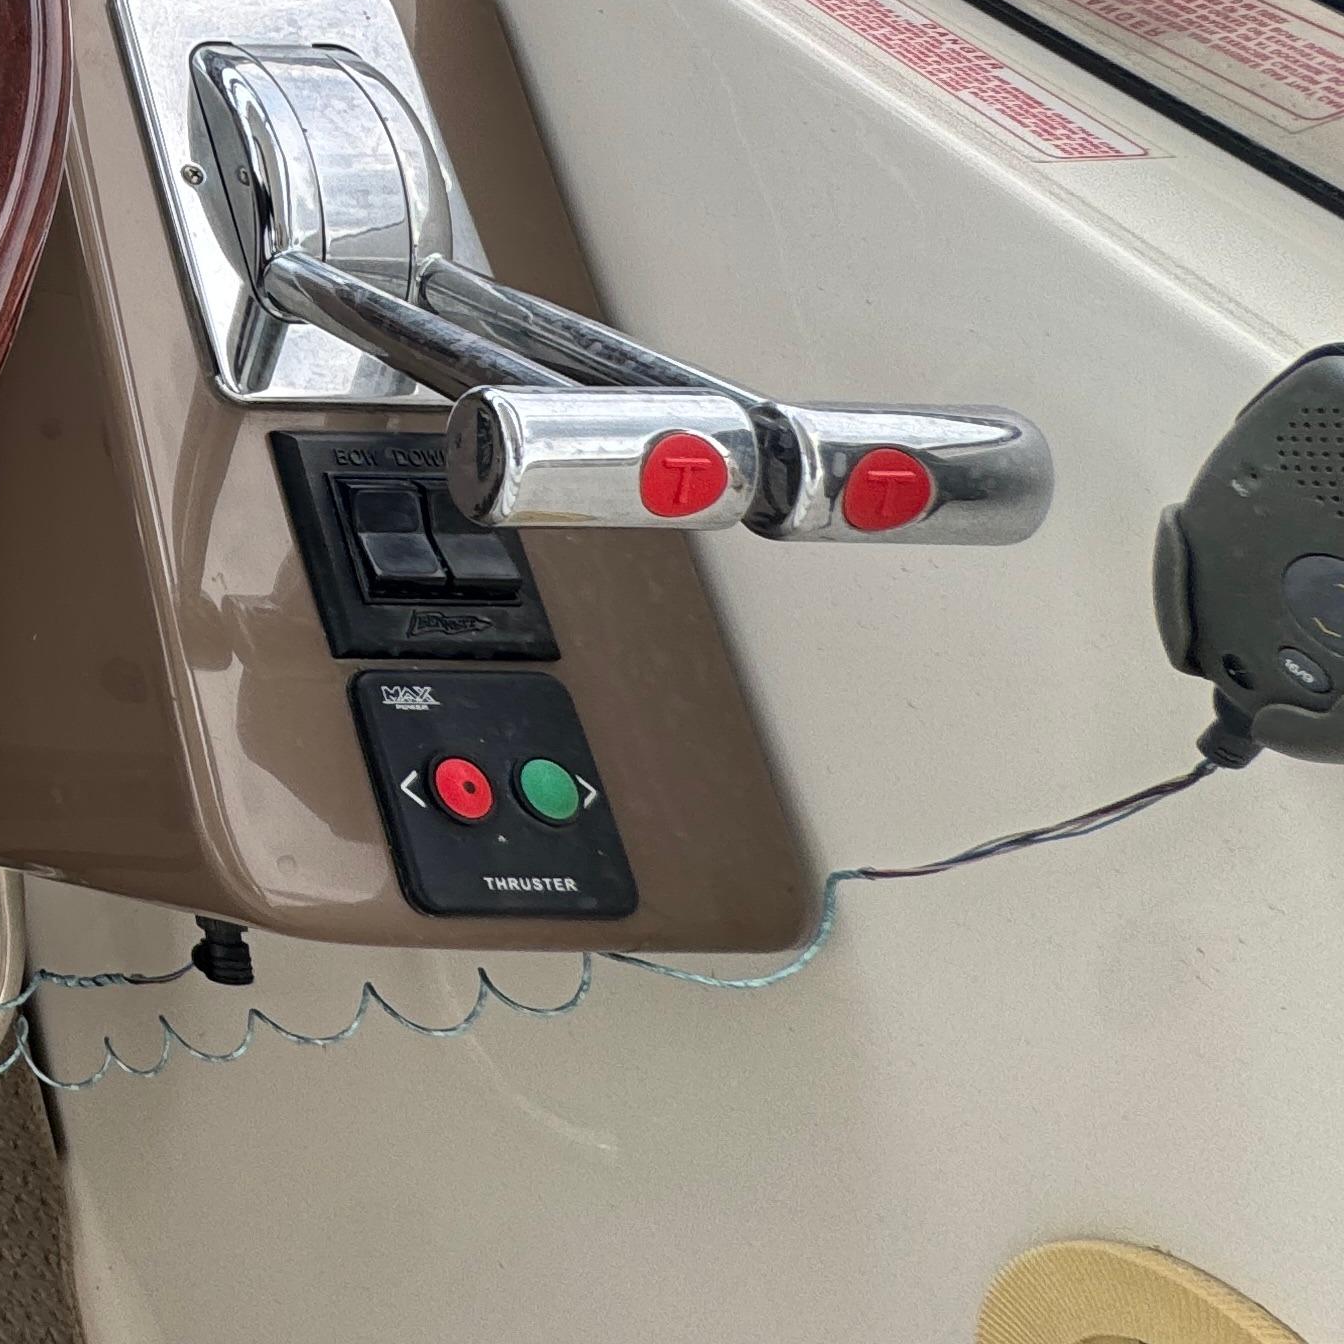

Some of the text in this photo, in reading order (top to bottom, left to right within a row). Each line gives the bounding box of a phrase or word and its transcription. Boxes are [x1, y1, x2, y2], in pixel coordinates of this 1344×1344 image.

[920, 22, 1005, 70] DANGER
[381, 686, 440, 705] MAX
[483, 876, 578, 892] THRUSTER
